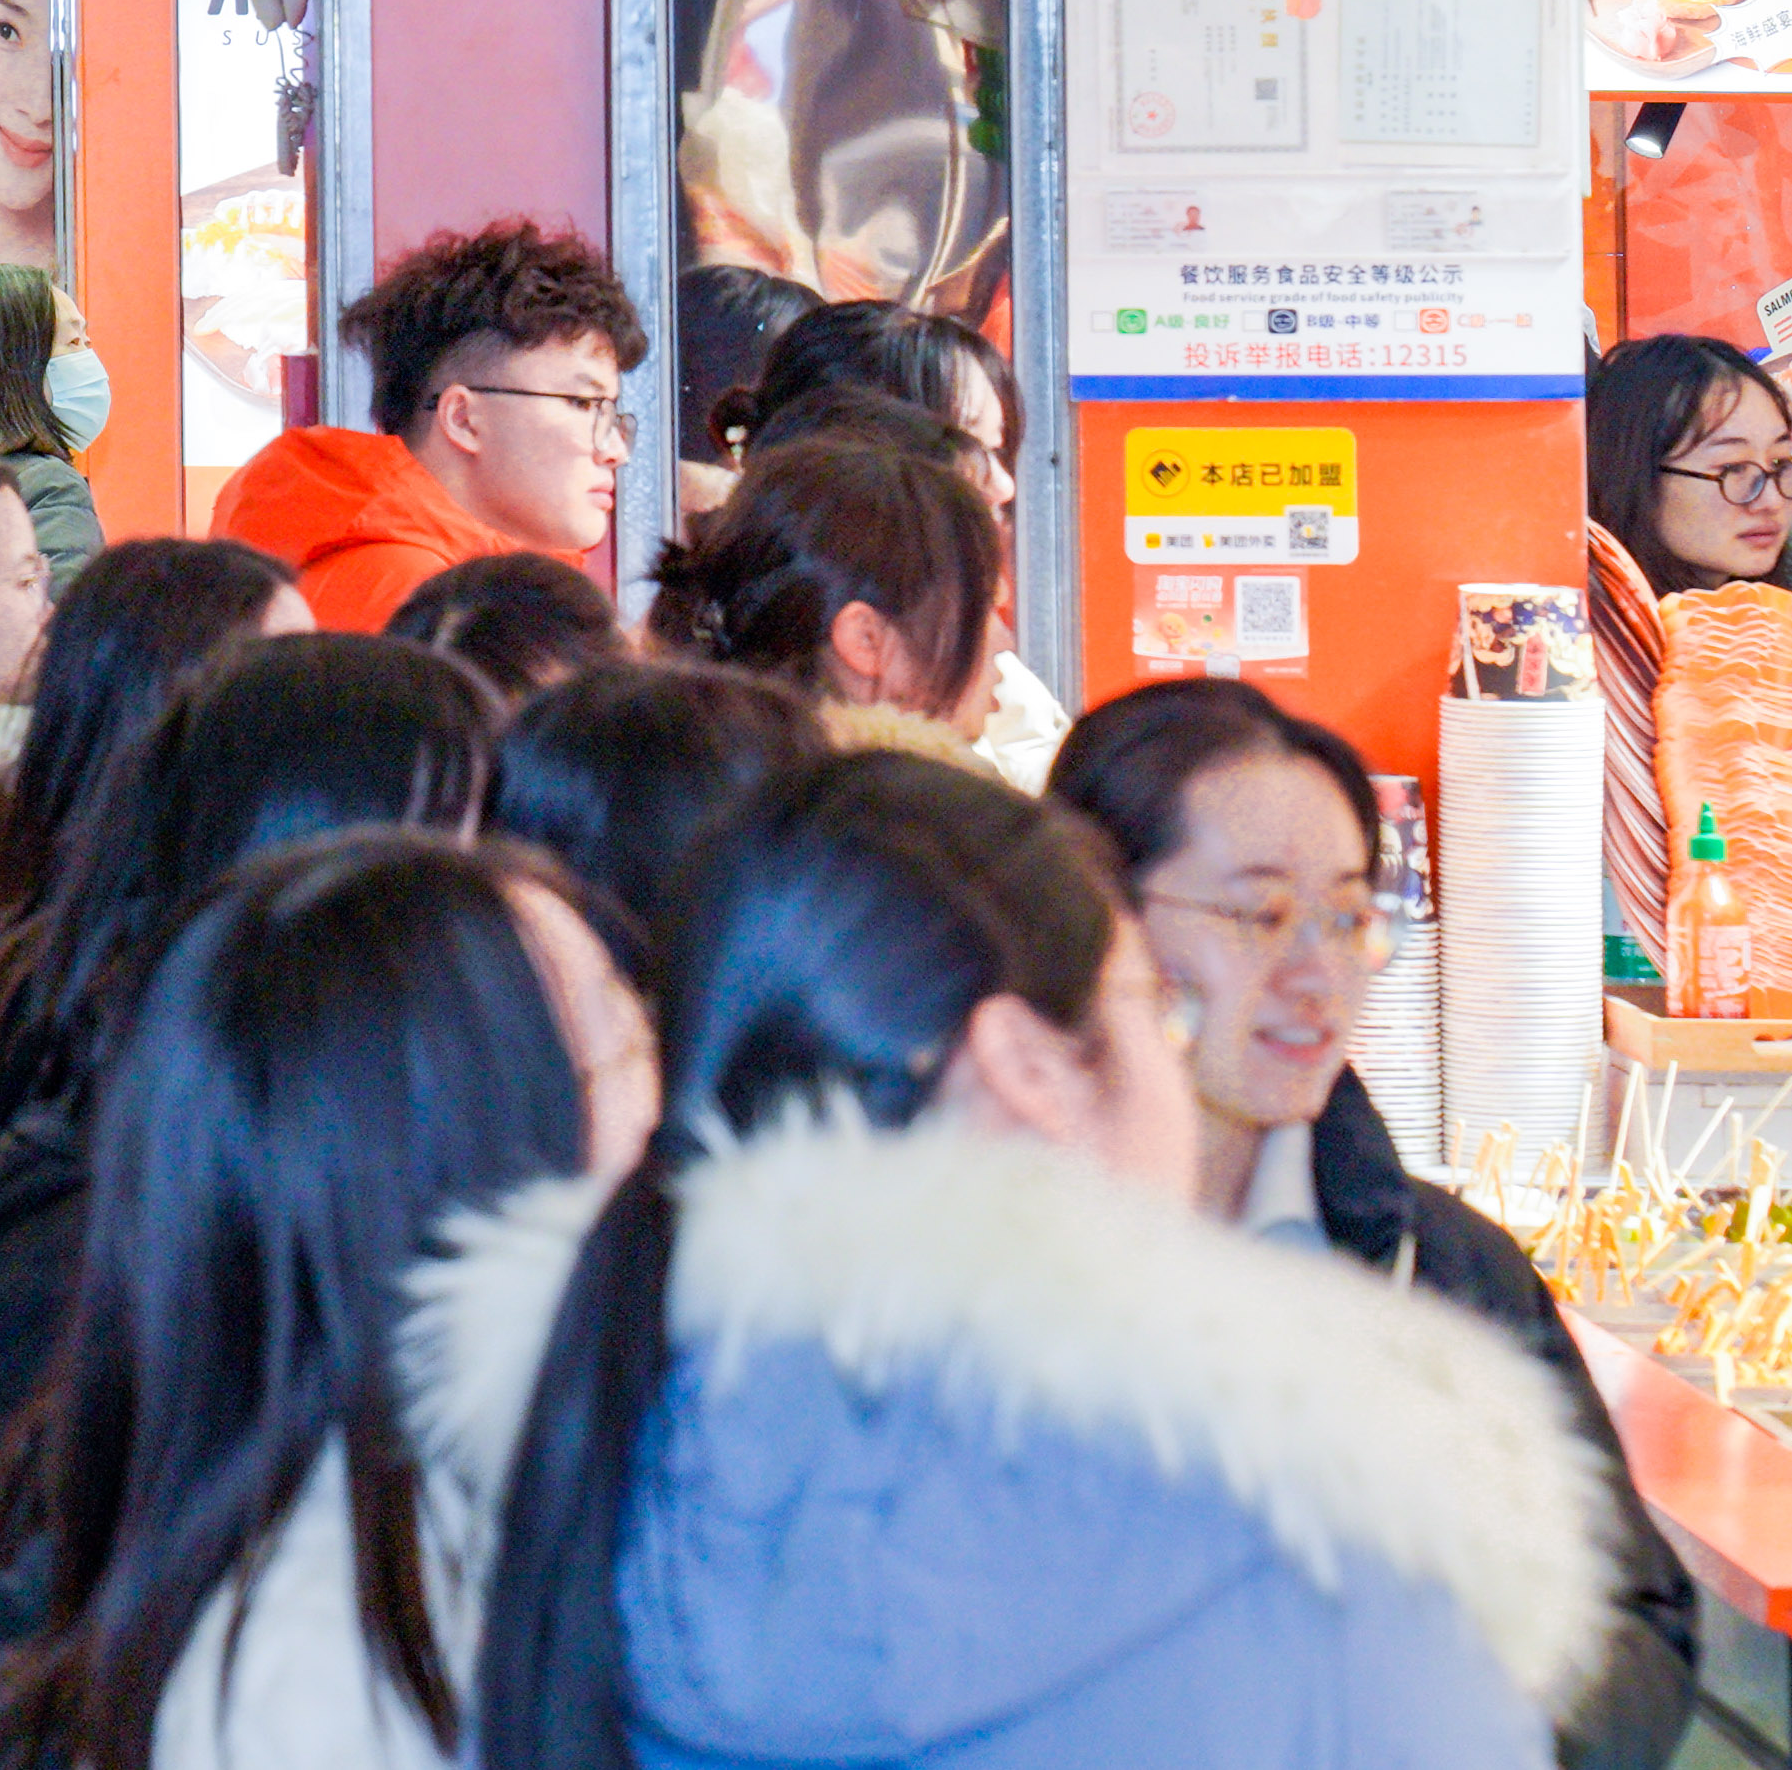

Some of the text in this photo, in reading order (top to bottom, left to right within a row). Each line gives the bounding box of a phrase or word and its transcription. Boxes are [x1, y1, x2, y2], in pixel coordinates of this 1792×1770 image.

[1180, 264, 1465, 286] 餐饮服务食品安全等级公示
[1183, 291, 1465, 304] Food service grade of food safety publicity
[1183, 341, 1468, 370] 投诉举报电话:12315
[1200, 462, 1342, 487] 本店已加盟
